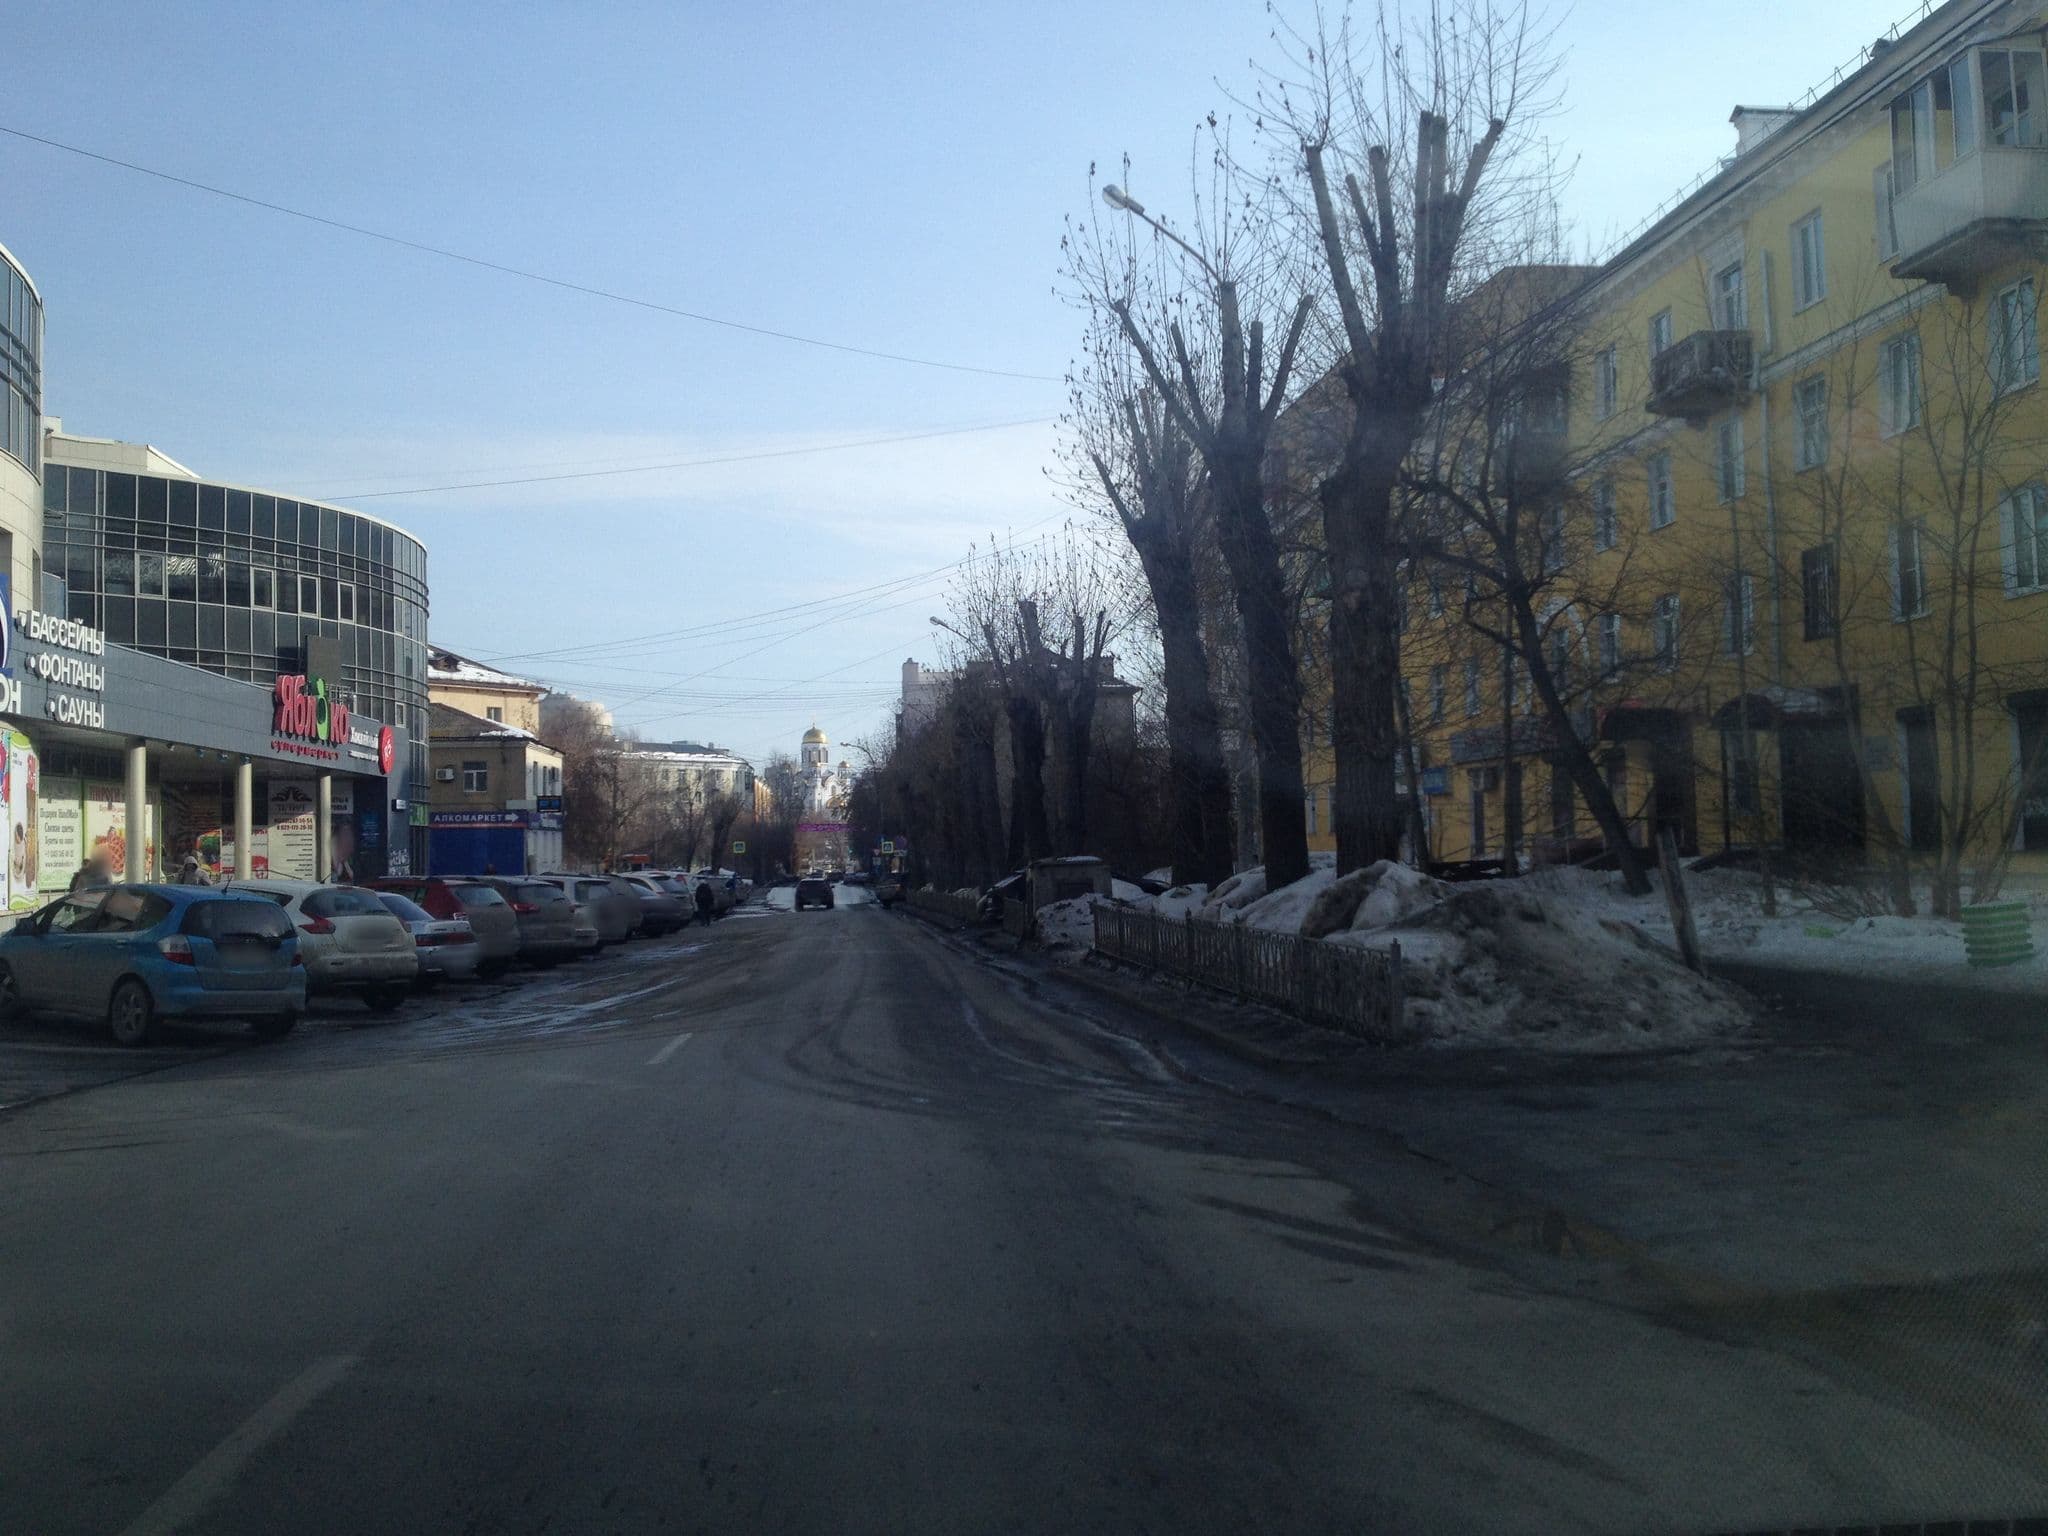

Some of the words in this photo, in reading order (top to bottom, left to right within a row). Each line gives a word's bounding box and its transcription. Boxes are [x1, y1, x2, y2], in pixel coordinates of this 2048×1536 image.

[29, 610, 105, 656] БАССЕЙНЫ
[37, 651, 105, 692] ФОНТАНЫ
[57, 694, 105, 729] САУНЫ
[434, 813, 503, 823] АЛКОМАРКЕТ
